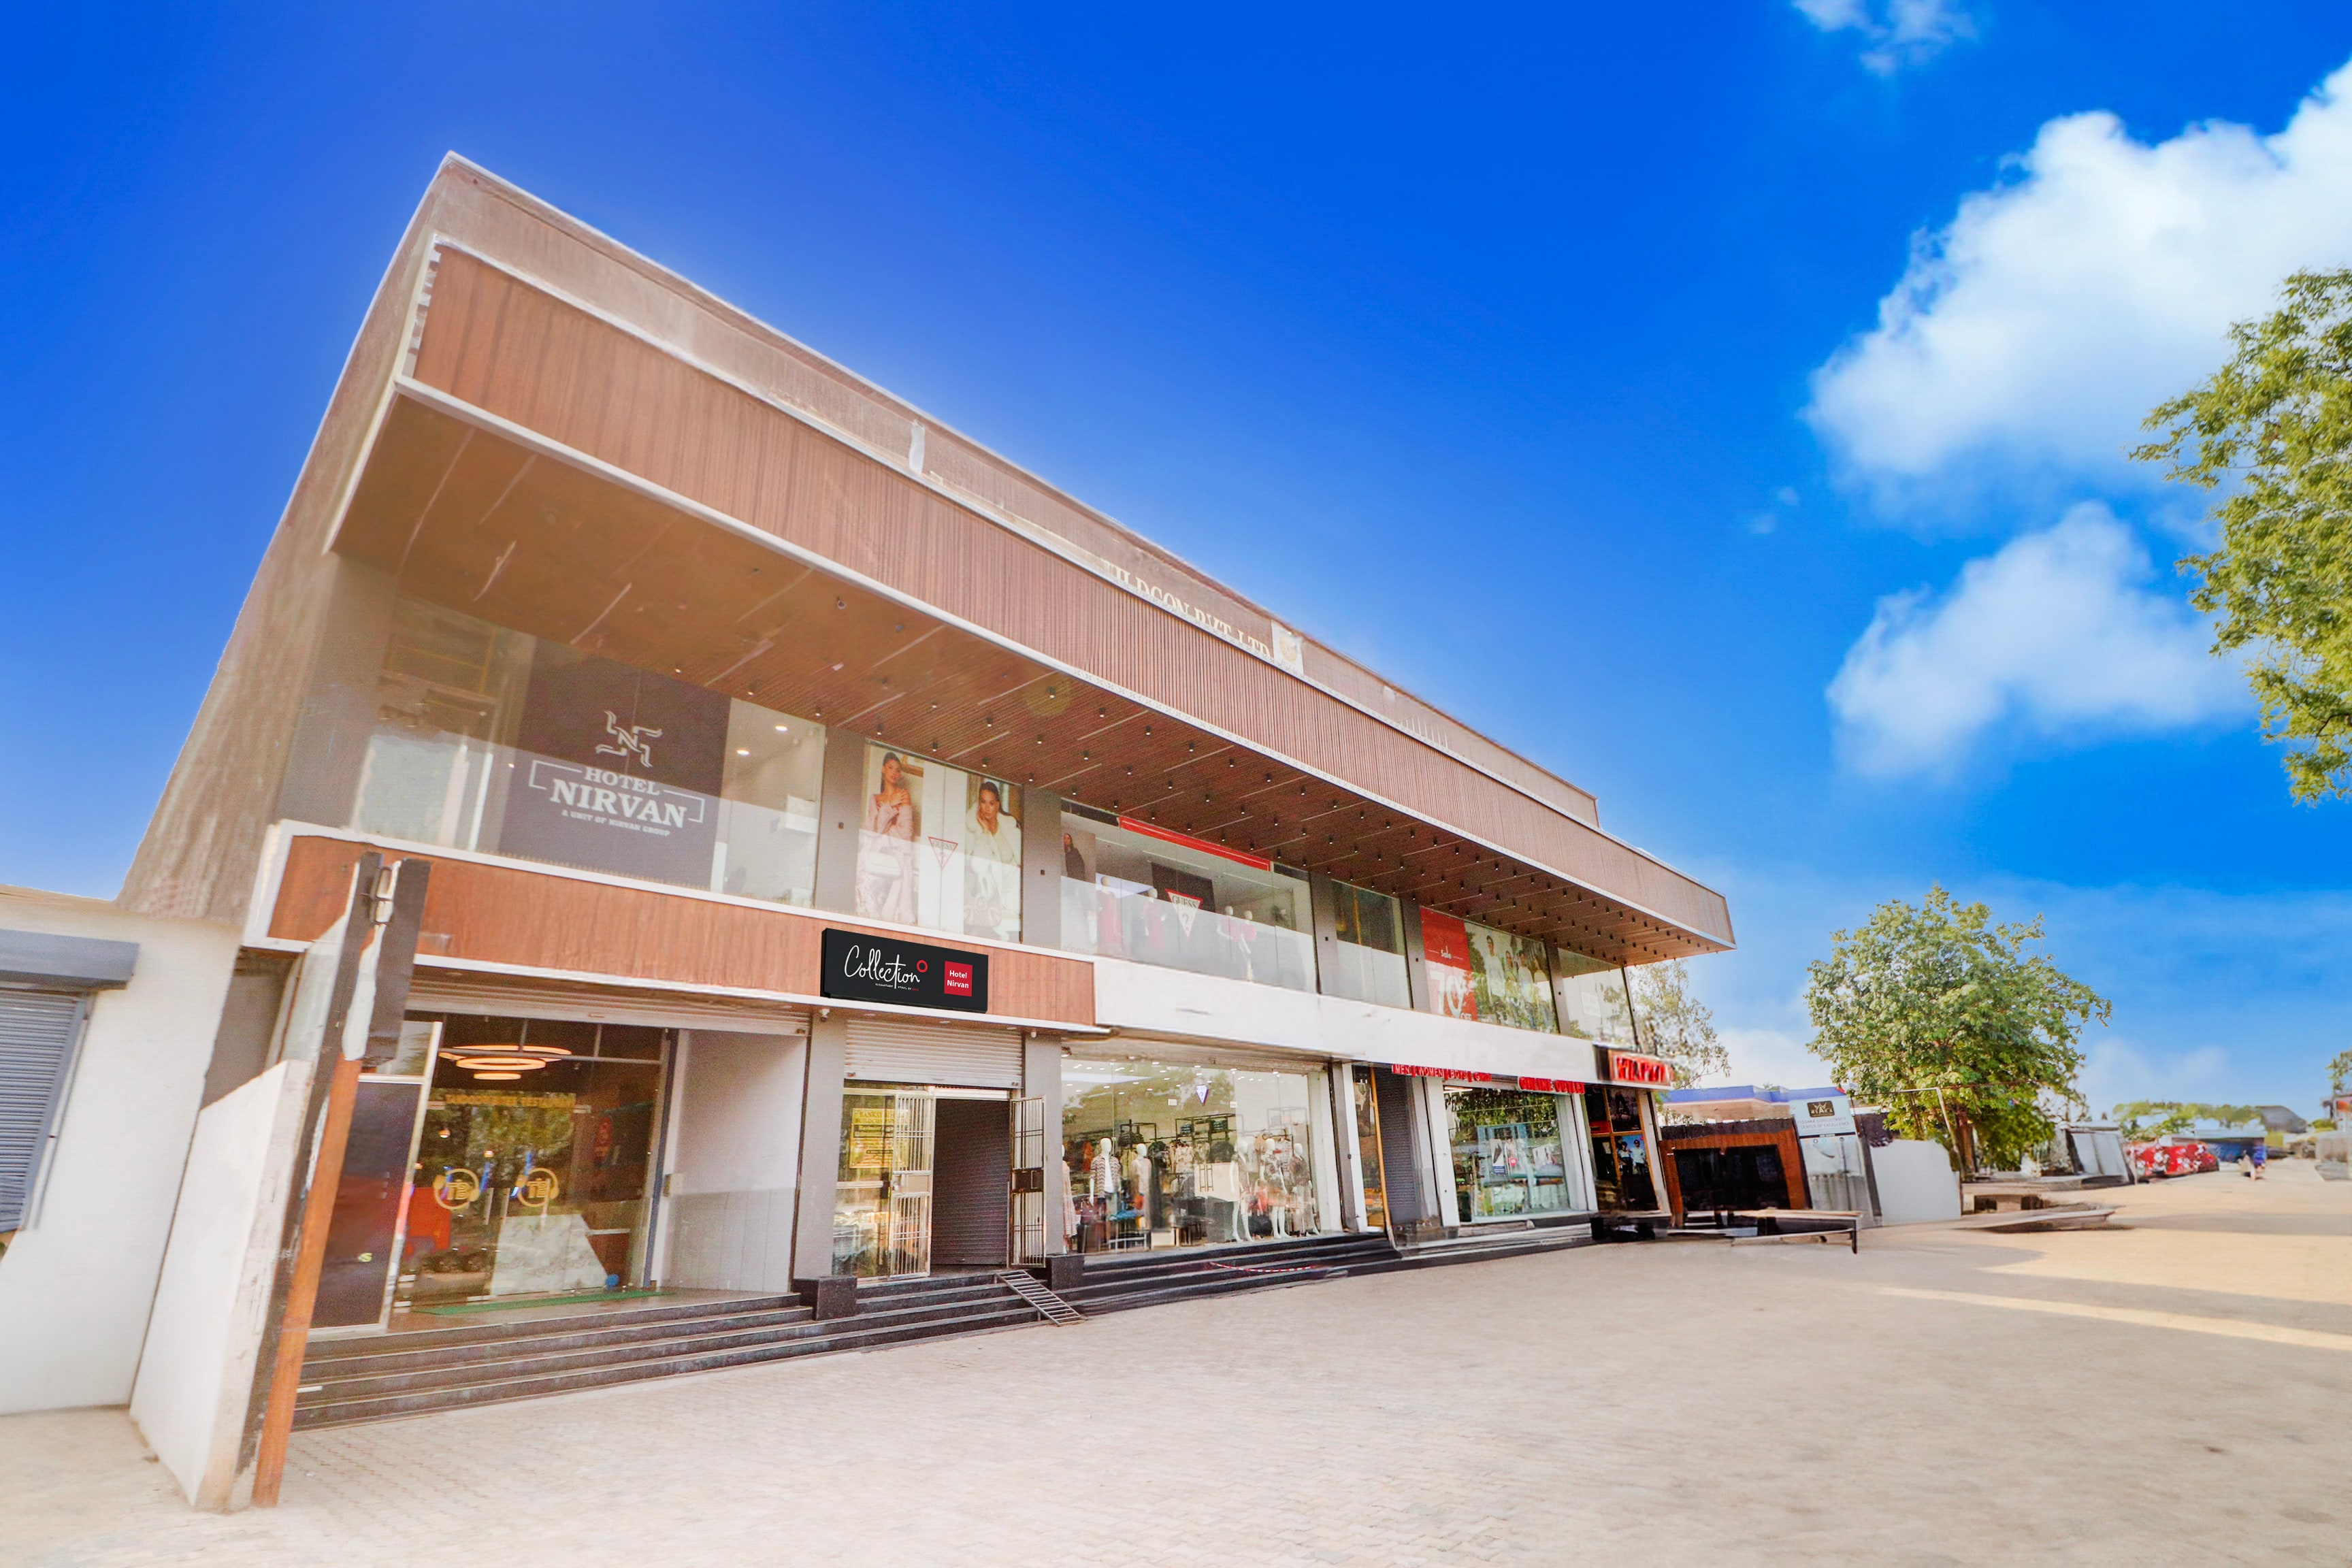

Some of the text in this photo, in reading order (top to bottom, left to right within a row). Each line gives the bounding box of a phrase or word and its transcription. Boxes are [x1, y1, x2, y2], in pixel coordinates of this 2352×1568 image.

[584, 766, 660, 796] HOTEL
[550, 778, 687, 828] NIRVAN
[570, 811, 593, 821] UNIT
[608, 819, 641, 831] NIRVAN
[642, 826, 670, 836] GROUP
[845, 945, 920, 990] Collection
[949, 970, 967, 979] Hotel
[947, 979, 969, 989] Nirvan
[1417, 1066, 1443, 1077] WOMEN
